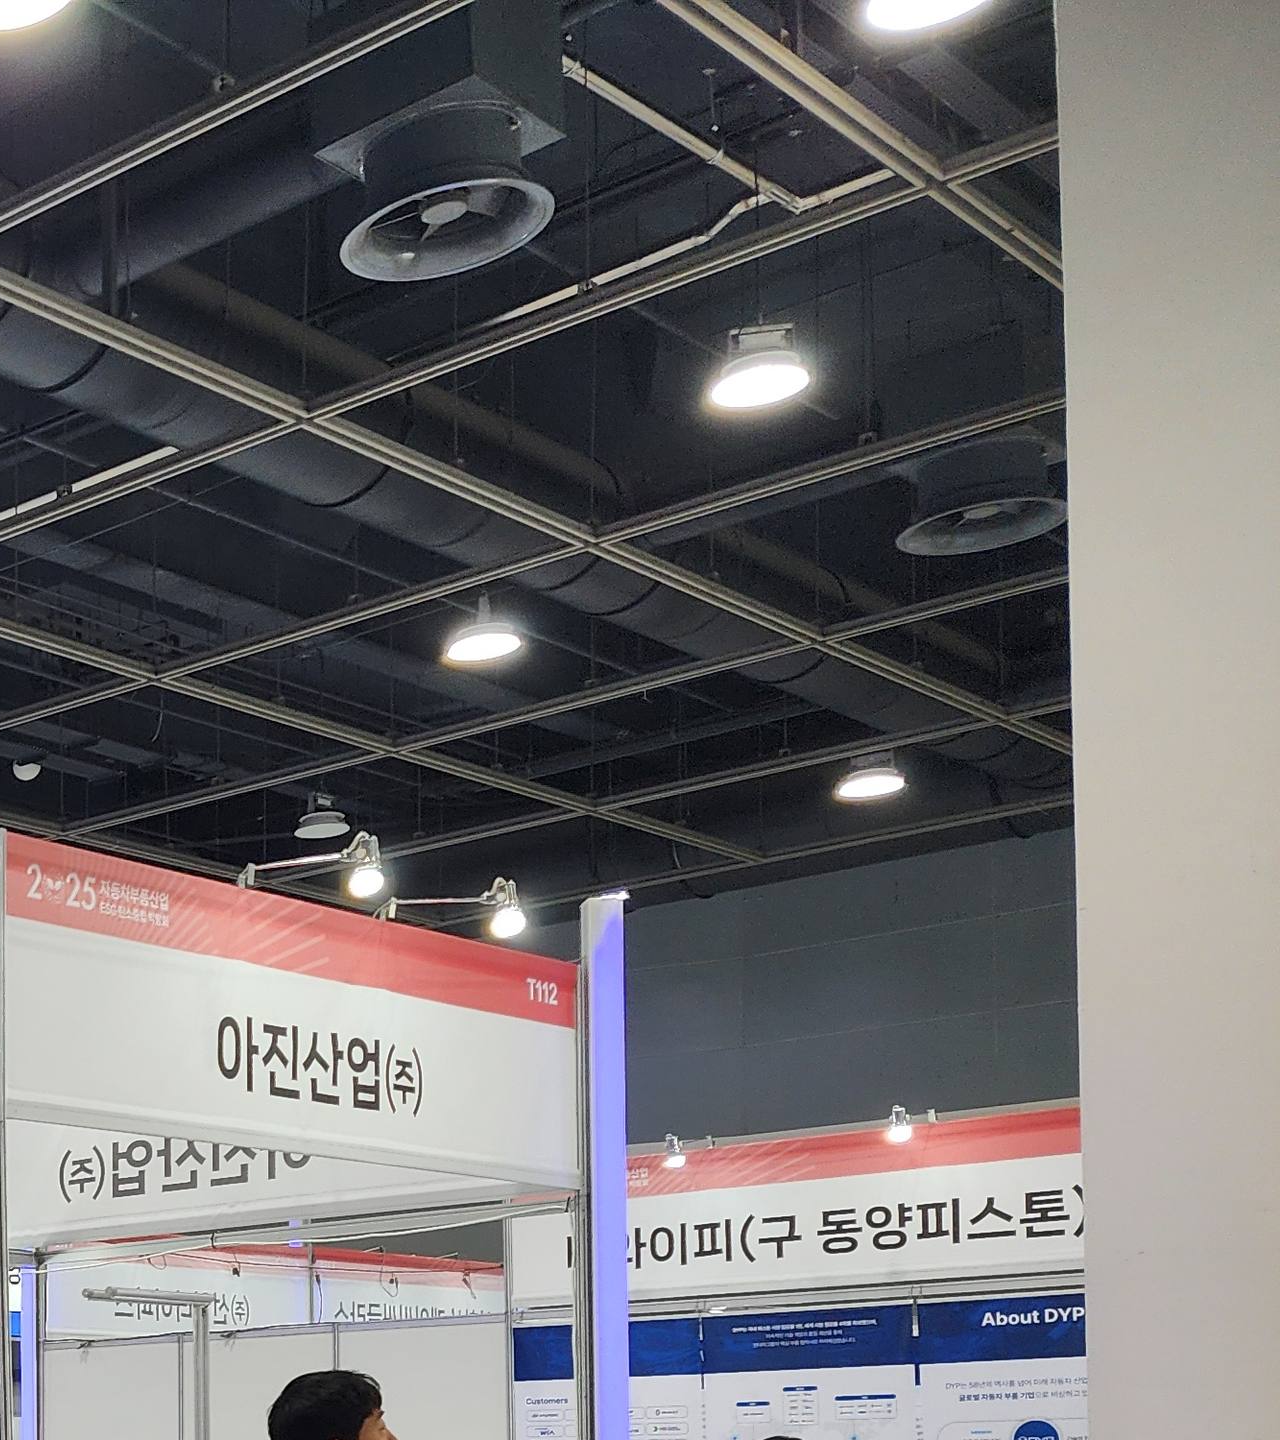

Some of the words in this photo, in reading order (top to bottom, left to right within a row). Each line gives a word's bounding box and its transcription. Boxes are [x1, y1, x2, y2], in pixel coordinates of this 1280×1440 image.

[526, 978, 558, 1006] T112
[217, 1016, 423, 1116] 아진산업(주)
[981, 1309, 1040, 1327] About
[1044, 1307, 1085, 1323] DYP
[526, 1397, 568, 1405] Customers
